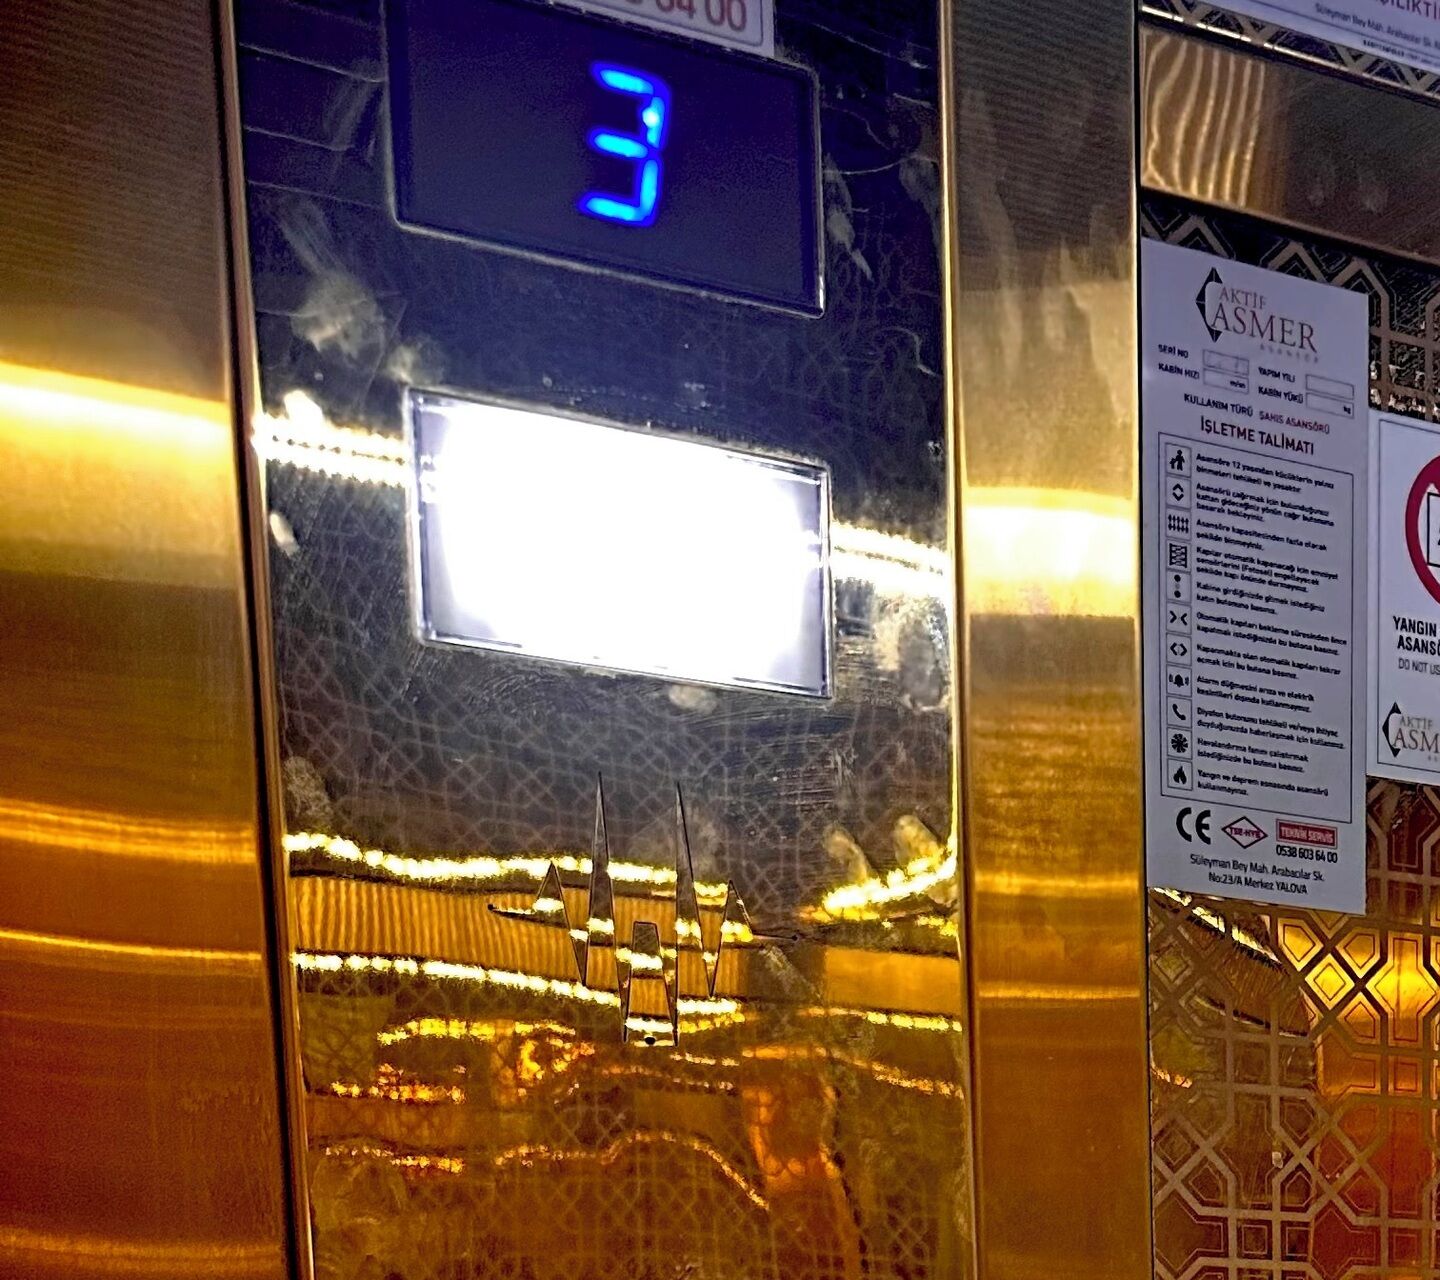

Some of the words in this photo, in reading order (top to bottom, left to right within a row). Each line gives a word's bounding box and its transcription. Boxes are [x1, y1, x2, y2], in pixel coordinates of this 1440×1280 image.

[581, 62, 671, 227] 3
[1219, 286, 1267, 310] AKTİF
[1212, 303, 1318, 353] ASMER
[1230, 403, 1253, 417] TÜRÜ
[1201, 415, 1255, 443] İŞLETME
[1259, 431, 1314, 455] TALİMATI
[1393, 616, 1437, 638] YANGIN
[1398, 658, 1410, 671] DO
[1412, 661, 1427, 673] NOT
[1176, 807, 1211, 845] CE
[1190, 853, 1231, 870] Süleyman
[1232, 860, 1248, 874] Bey
[1276, 844, 1297, 857] 0538
[1316, 849, 1326, 862] 64
[1327, 851, 1338, 863] 00
[1276, 881, 1308, 894] YALOVA
